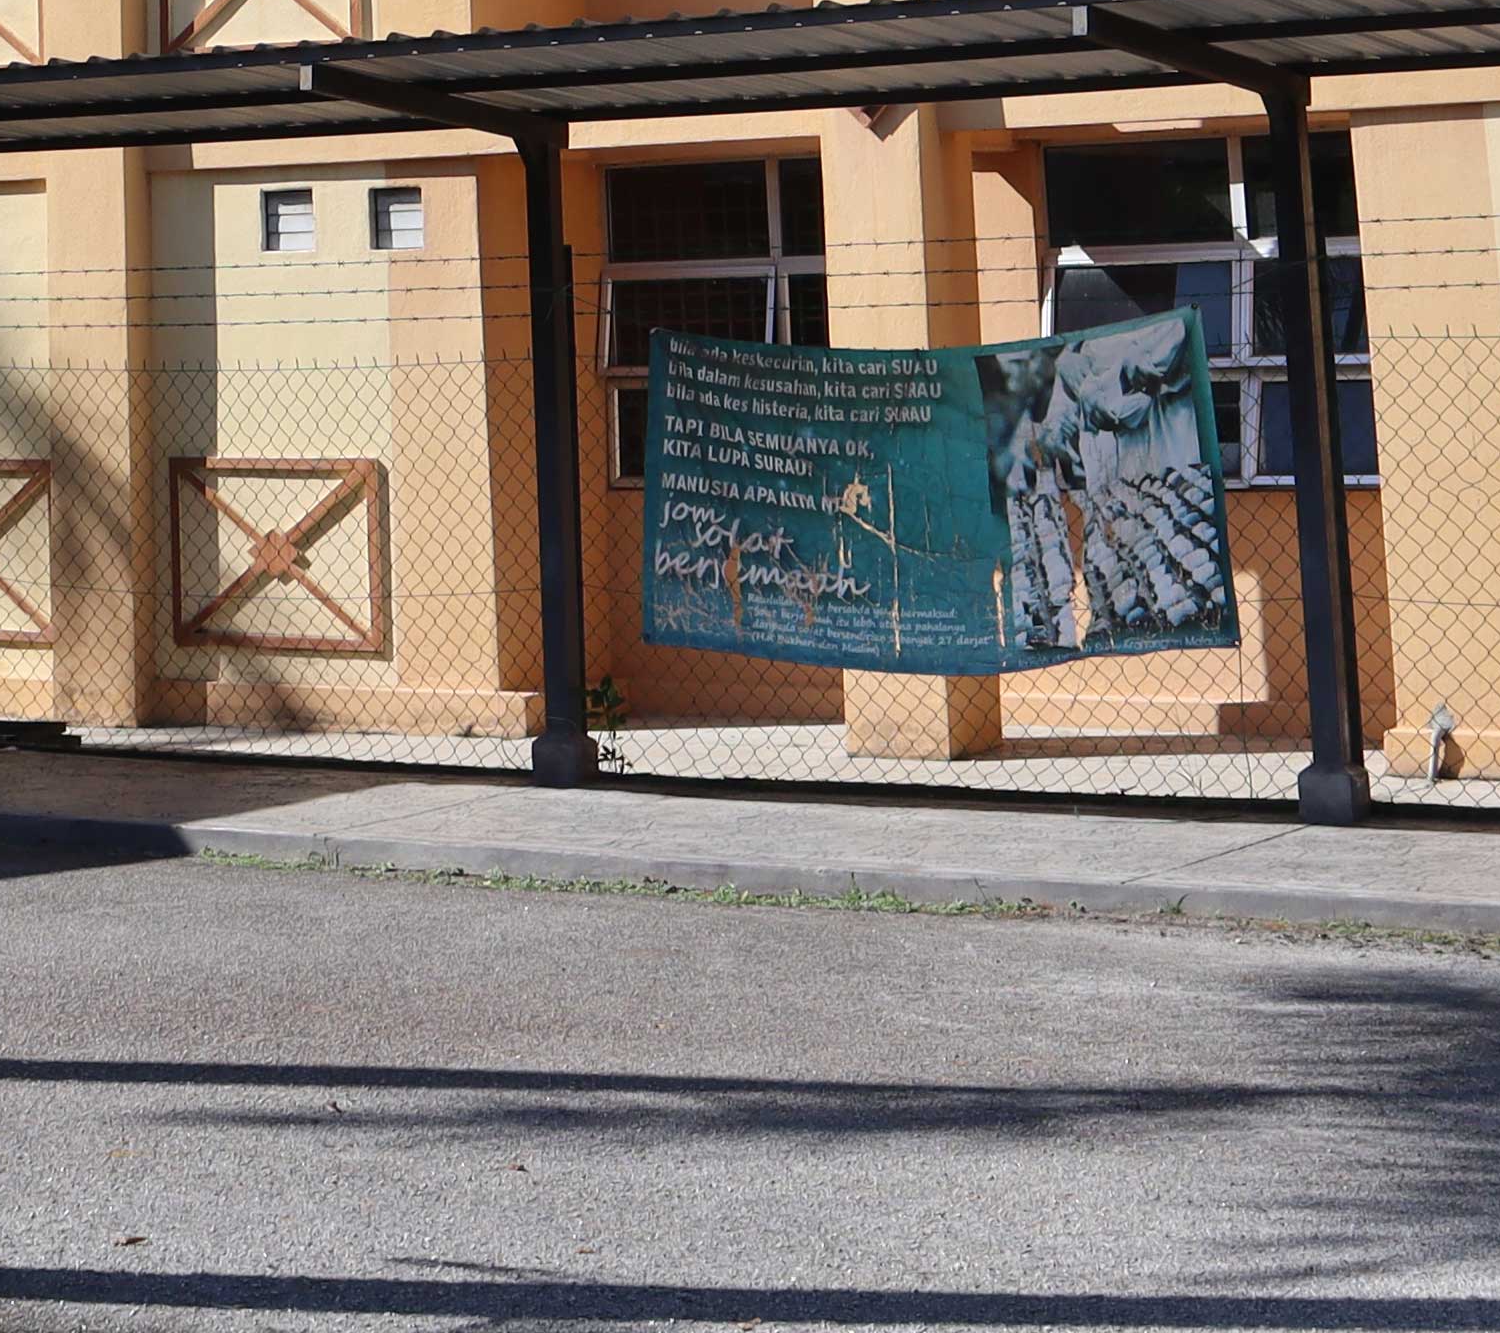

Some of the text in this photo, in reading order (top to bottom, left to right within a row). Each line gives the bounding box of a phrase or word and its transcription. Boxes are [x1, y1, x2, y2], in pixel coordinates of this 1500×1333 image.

[668, 360, 693, 379] bila
[697, 366, 740, 387] dalam
[744, 374, 821, 399] kesusahan,
[824, 381, 856, 398] kita
[862, 382, 890, 399] cari
[822, 357, 853, 374] kita
[855, 360, 887, 375] cari
[666, 381, 695, 401] bila
[723, 393, 748, 411] kes
[752, 398, 811, 422] histeria,
[815, 405, 845, 421] kita
[850, 406, 880, 422] cari
[663, 438, 702, 459] KITA
[708, 445, 750, 468] LUPA
[665, 415, 874, 460] TAPI BILA SEMUANYA OK,
[659, 492, 726, 528] jom
[661, 473, 740, 500] MANUSIA
[744, 485, 777, 505] APA
[780, 491, 817, 511] KITA
[937, 636, 952, 645] 27
